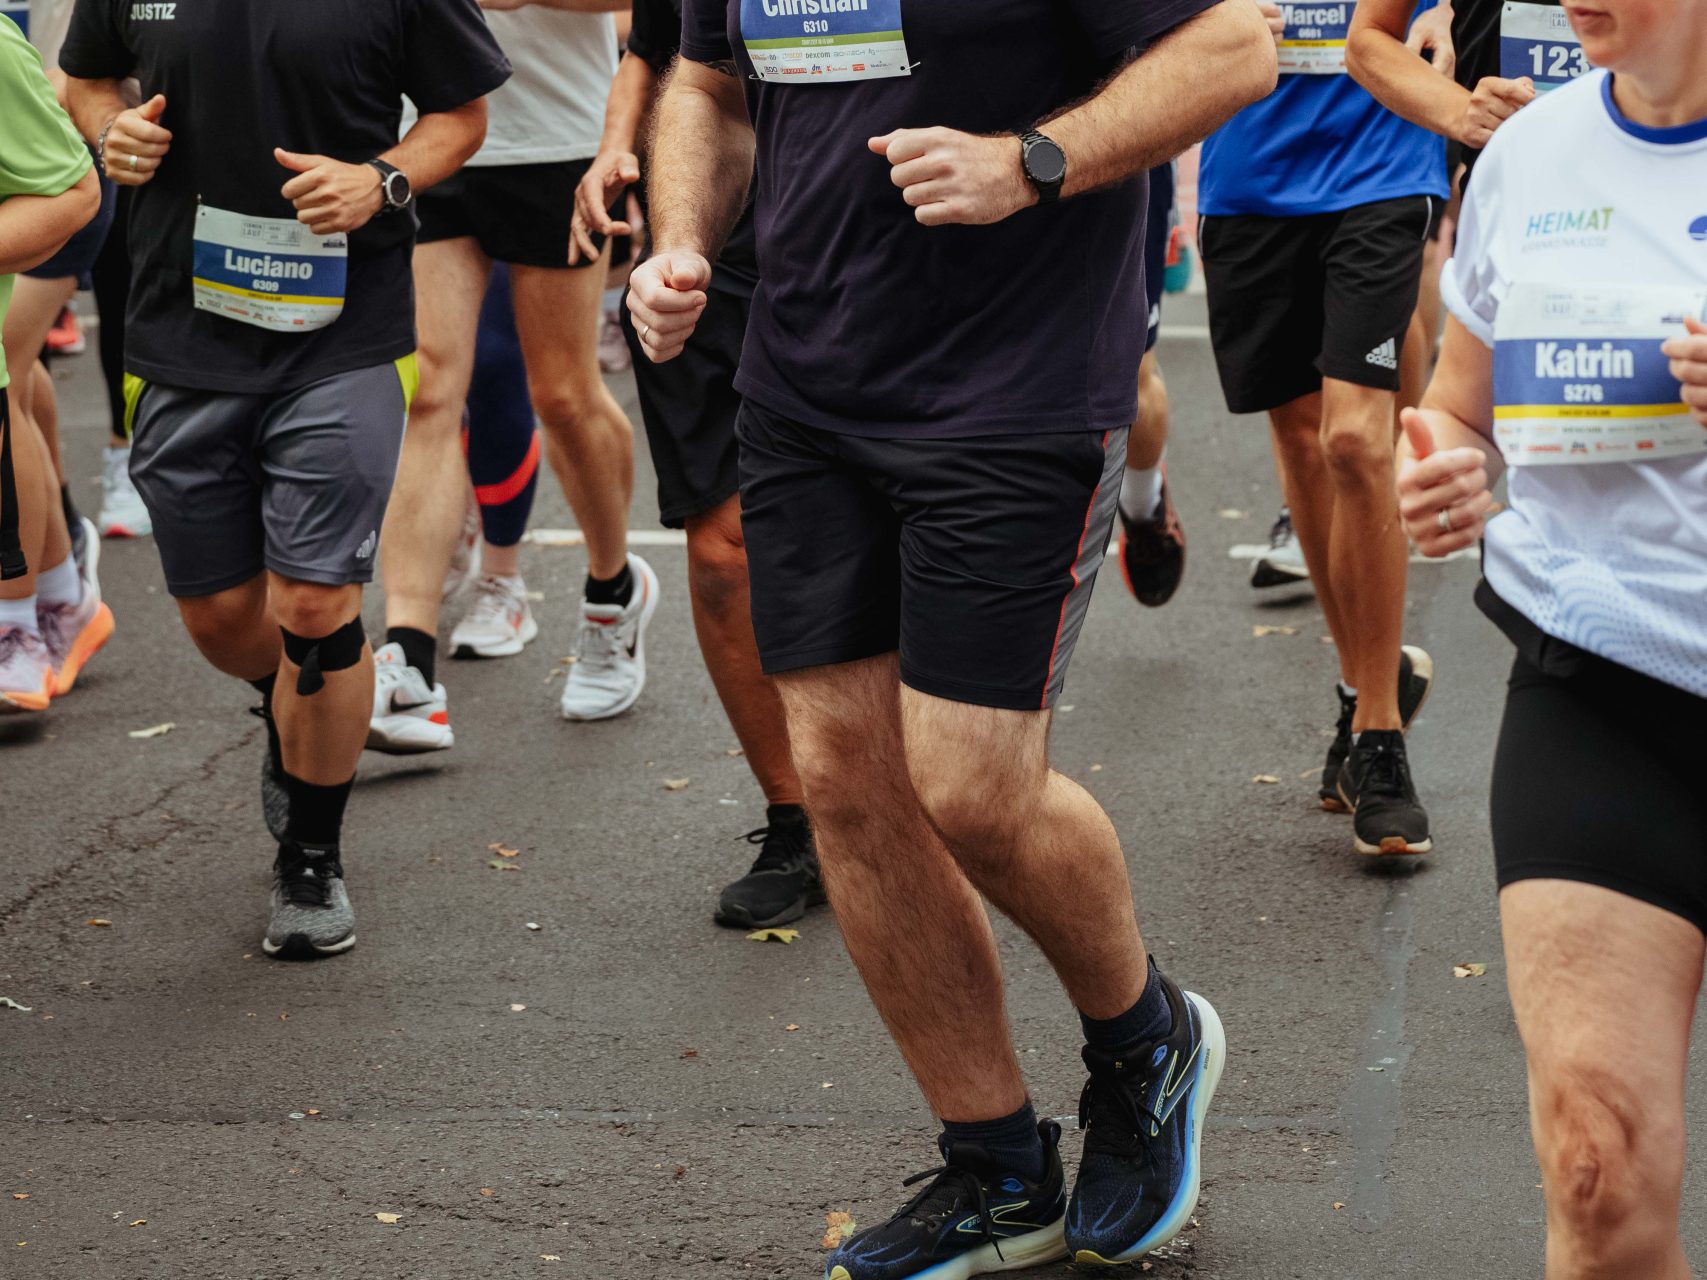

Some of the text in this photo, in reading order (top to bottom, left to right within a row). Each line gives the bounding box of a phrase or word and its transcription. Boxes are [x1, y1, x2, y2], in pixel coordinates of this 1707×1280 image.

[130, 2, 177, 21] JUSTIZ
[803, 19, 829, 33] 6310
[1525, 207, 1615, 238] HEIMAT
[224, 248, 314, 281] Luciano
[252, 278, 280, 292] 6309
[1534, 341, 1635, 379] Katrin
